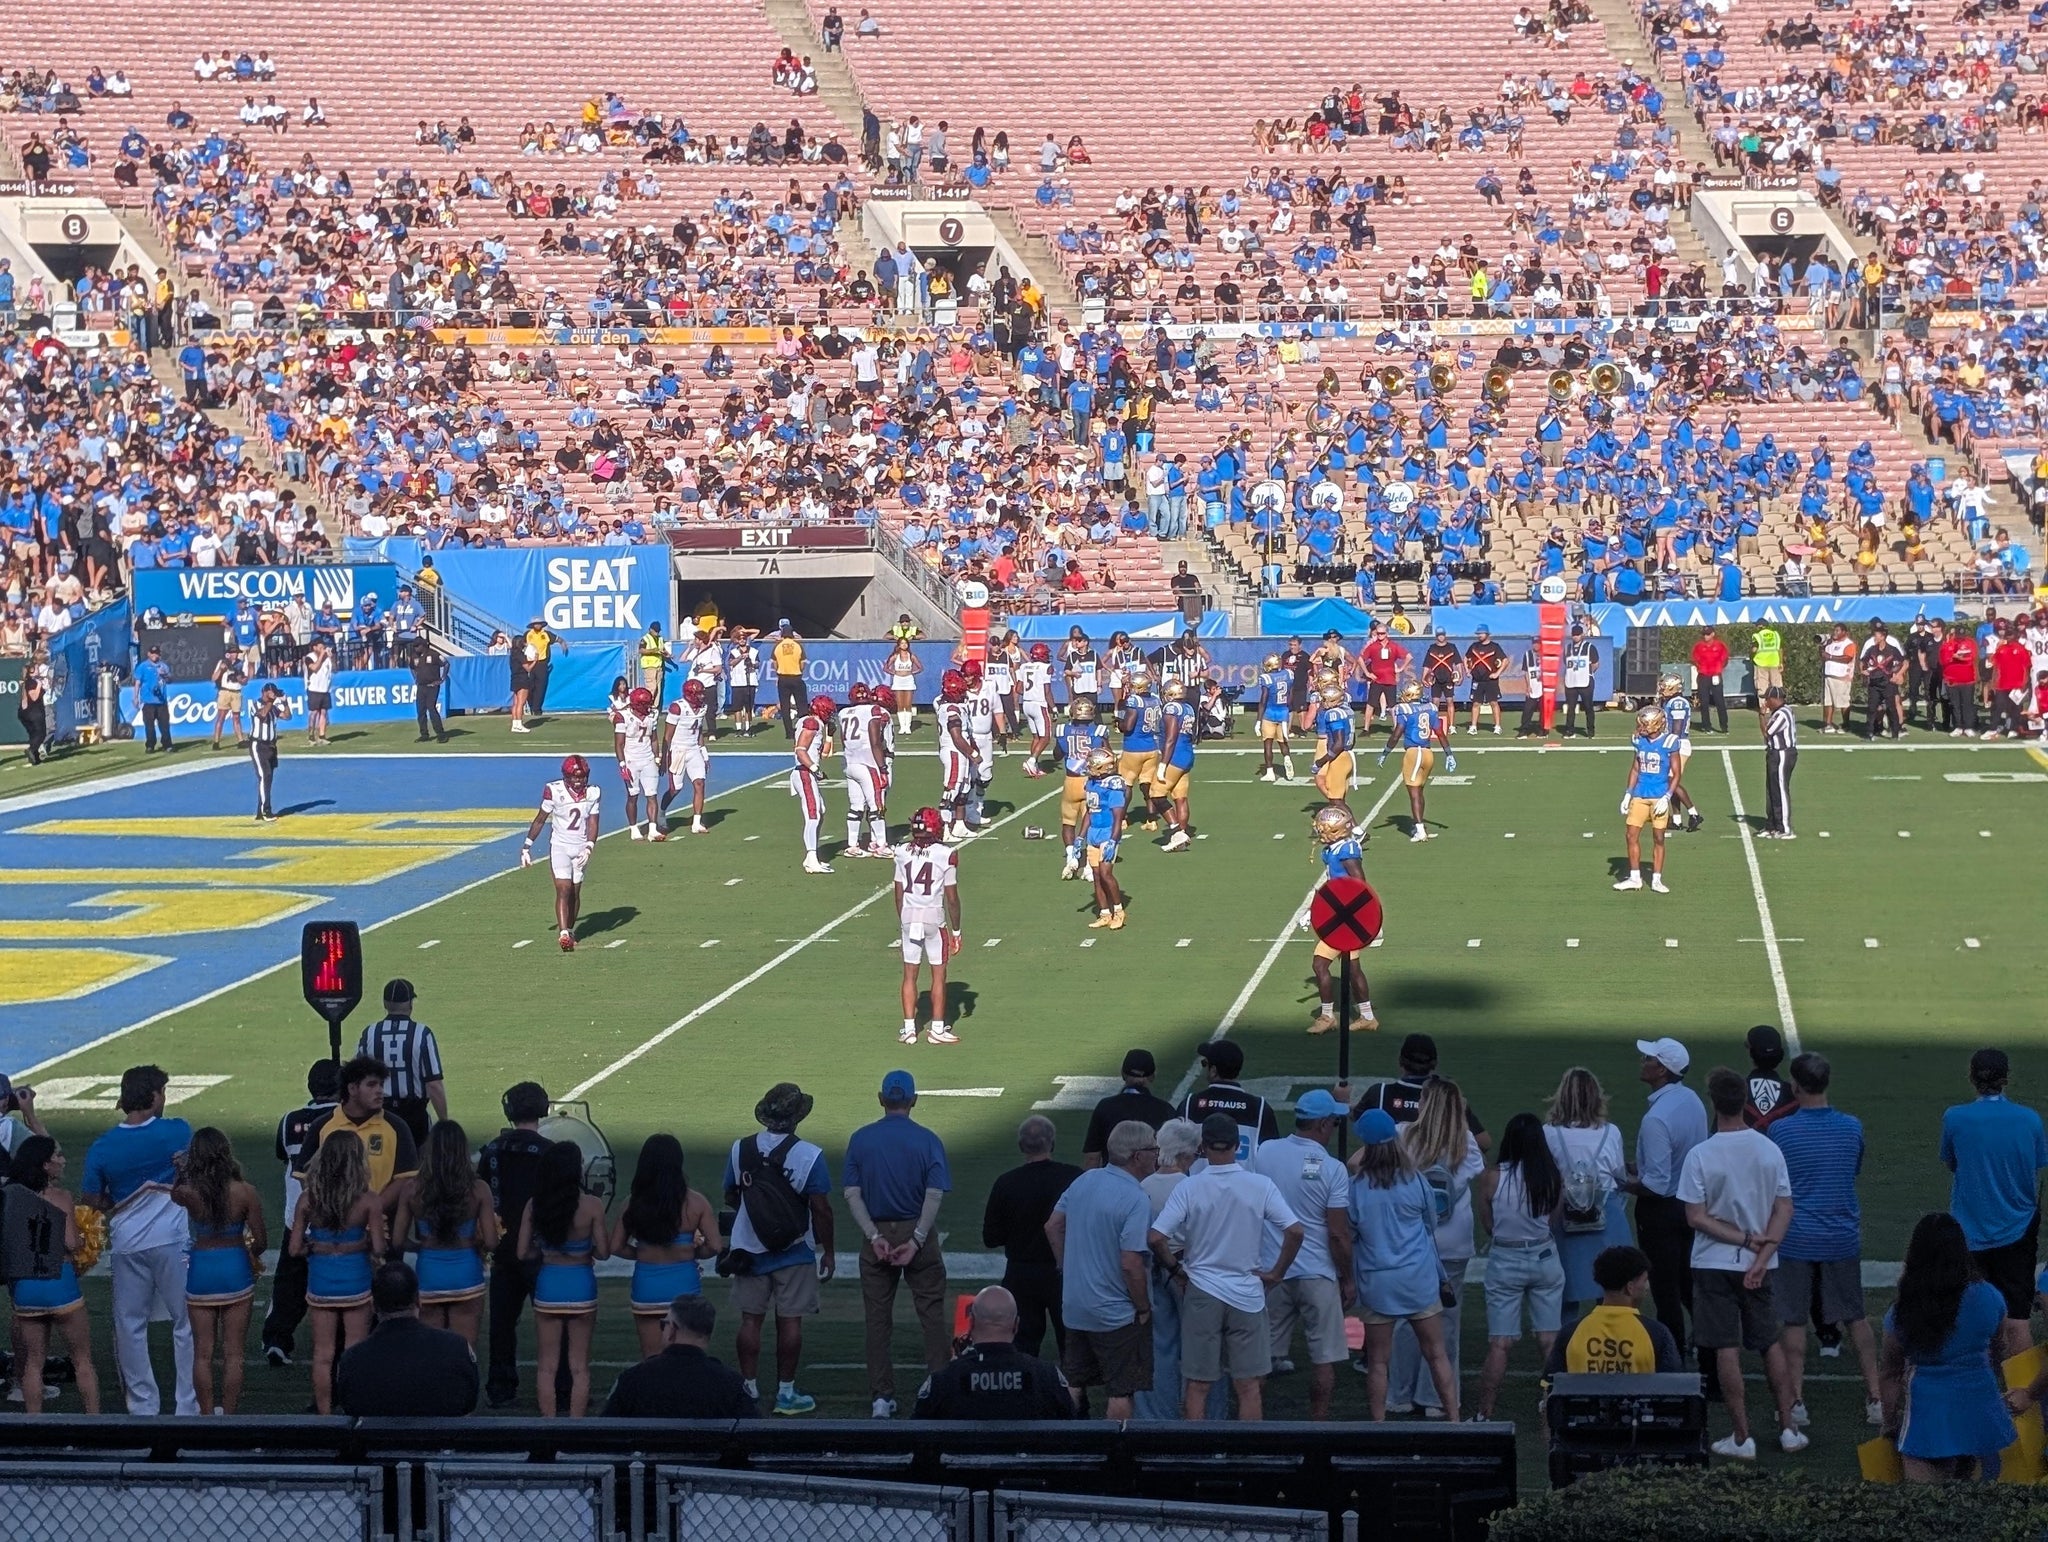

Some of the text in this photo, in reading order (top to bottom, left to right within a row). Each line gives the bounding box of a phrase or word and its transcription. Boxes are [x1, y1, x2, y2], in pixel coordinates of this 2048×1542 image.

[68, 219, 81, 236] 8
[1776, 212, 1788, 227] 6
[945, 223, 957, 239] 7
[570, 332, 631, 344] our den
[741, 528, 792, 547] EXIT
[547, 556, 638, 593] SEAT
[757, 558, 779, 575] 7A
[179, 570, 306, 600] WESCOM
[544, 594, 642, 631] GEEK
[1025, 671, 1034, 692] 5
[1276, 681, 1287, 704] 2
[335, 685, 388, 707] SILVER
[969, 698, 990, 717] 78
[638, 725, 647, 743] 7
[690, 718, 699, 735] 4
[842, 716, 861, 741] 72
[1418, 712, 1430, 740] 9
[1066, 735, 1092, 760] 15
[1639, 751, 1661, 774] 12
[567, 807, 581, 831] 2
[903, 860, 935, 896] 14
[381, 1033, 407, 1068] H
[1750, 1078, 1781, 1102] PAC
[1208, 1100, 1247, 1110] STRAUSS
[1586, 1337, 1634, 1359] CSC
[1587, 1359, 1633, 1373] EVENT
[970, 1371, 1023, 1391] POLICE
